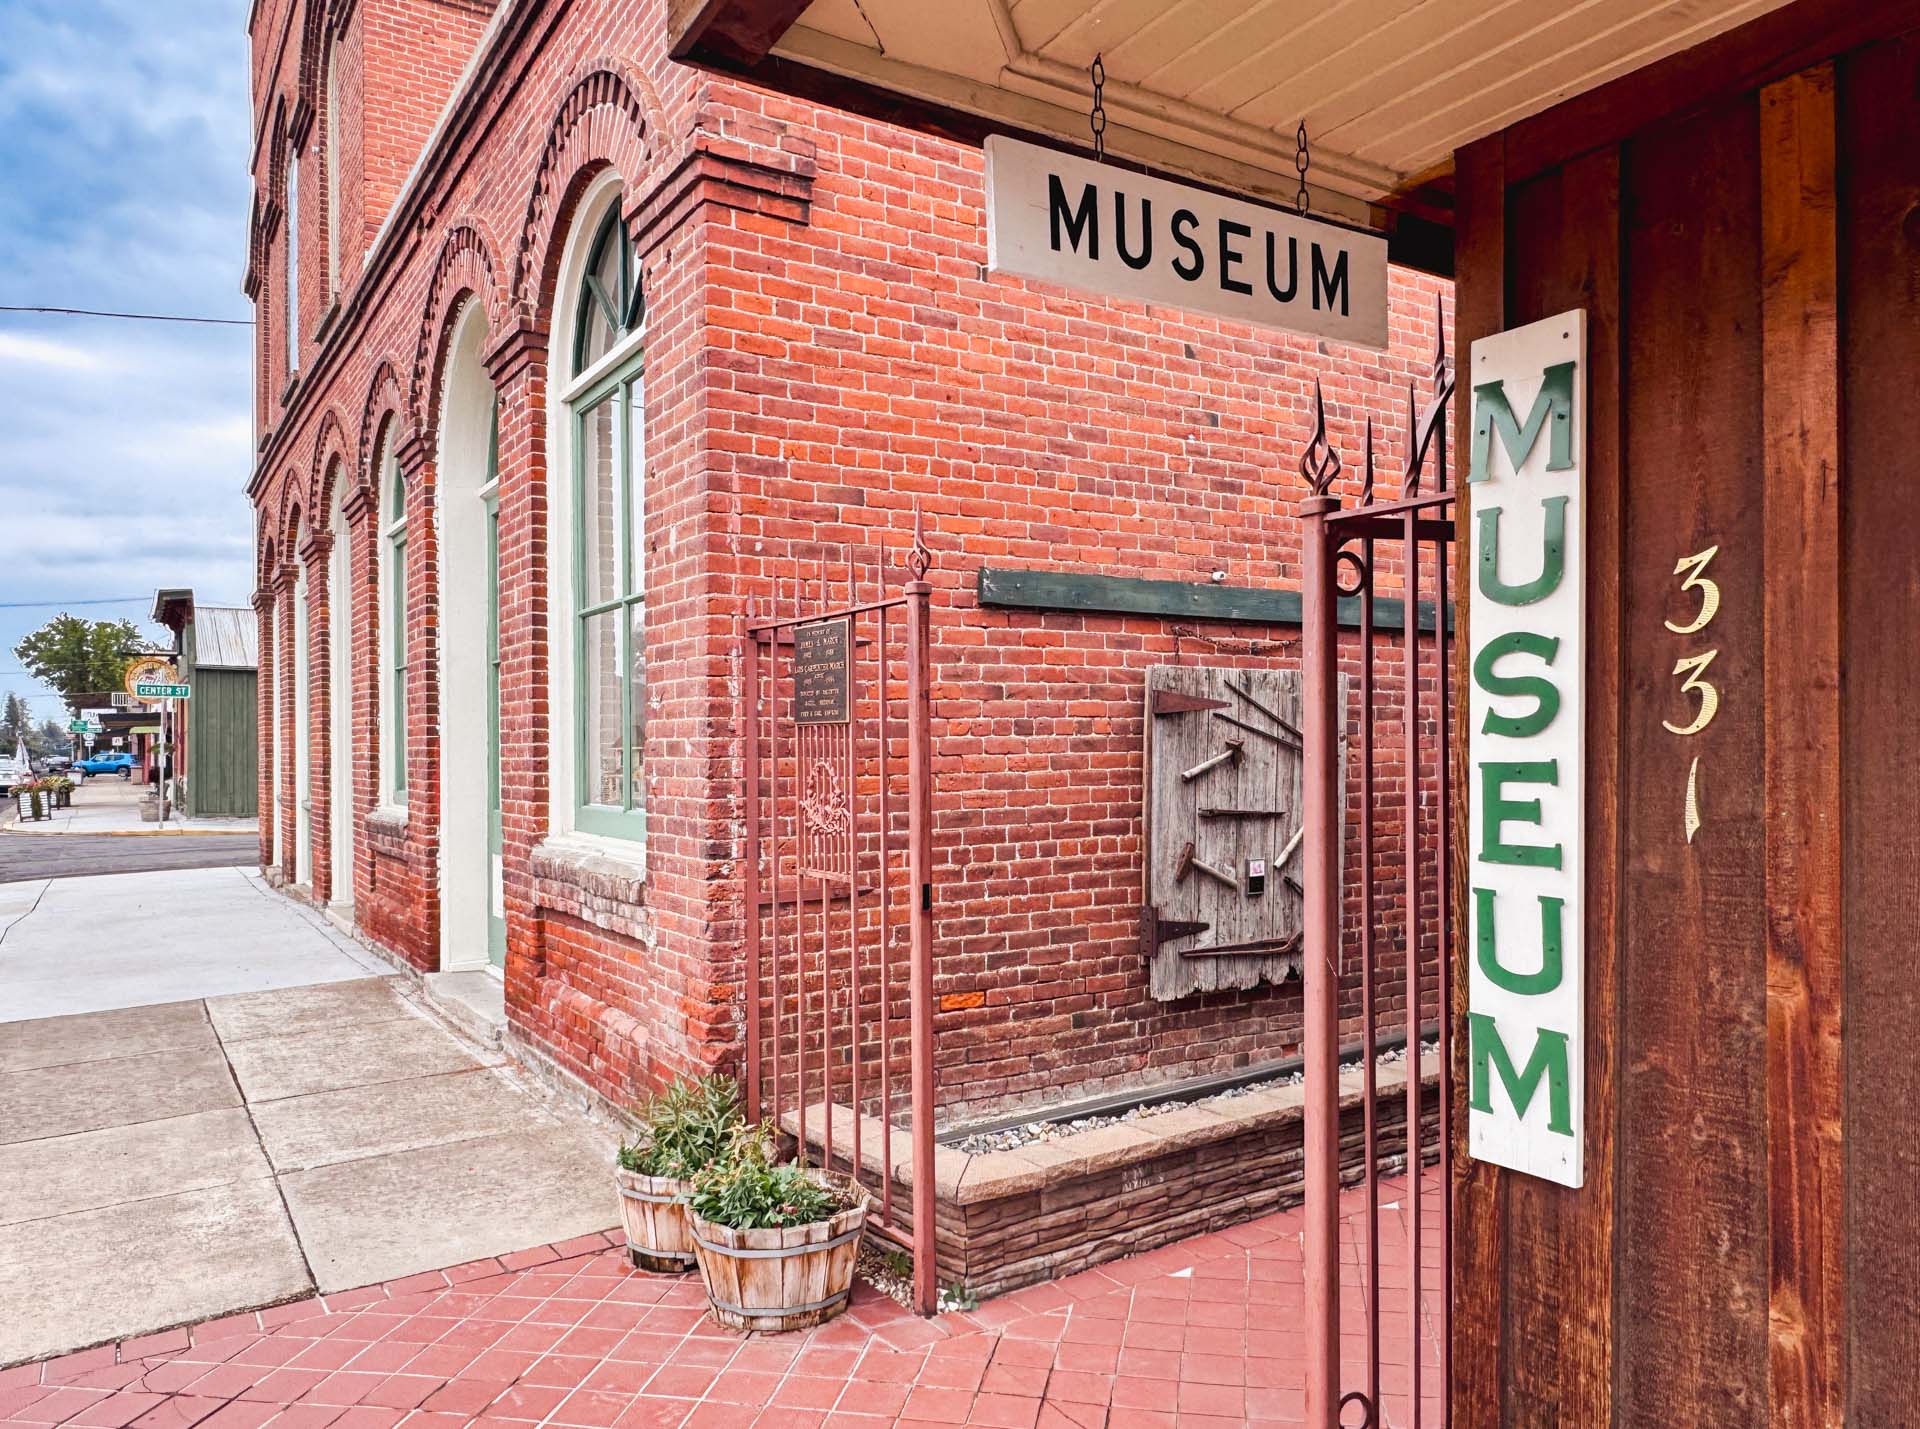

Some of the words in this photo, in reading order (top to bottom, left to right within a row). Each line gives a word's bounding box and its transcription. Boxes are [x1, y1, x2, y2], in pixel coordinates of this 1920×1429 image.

[1048, 174, 1349, 316] MUSEUM
[140, 686, 171, 695] CENTER
[175, 686, 186, 696] ST
[1467, 361, 1576, 1136] MUSEUM
[1663, 545, 1720, 843] 331
